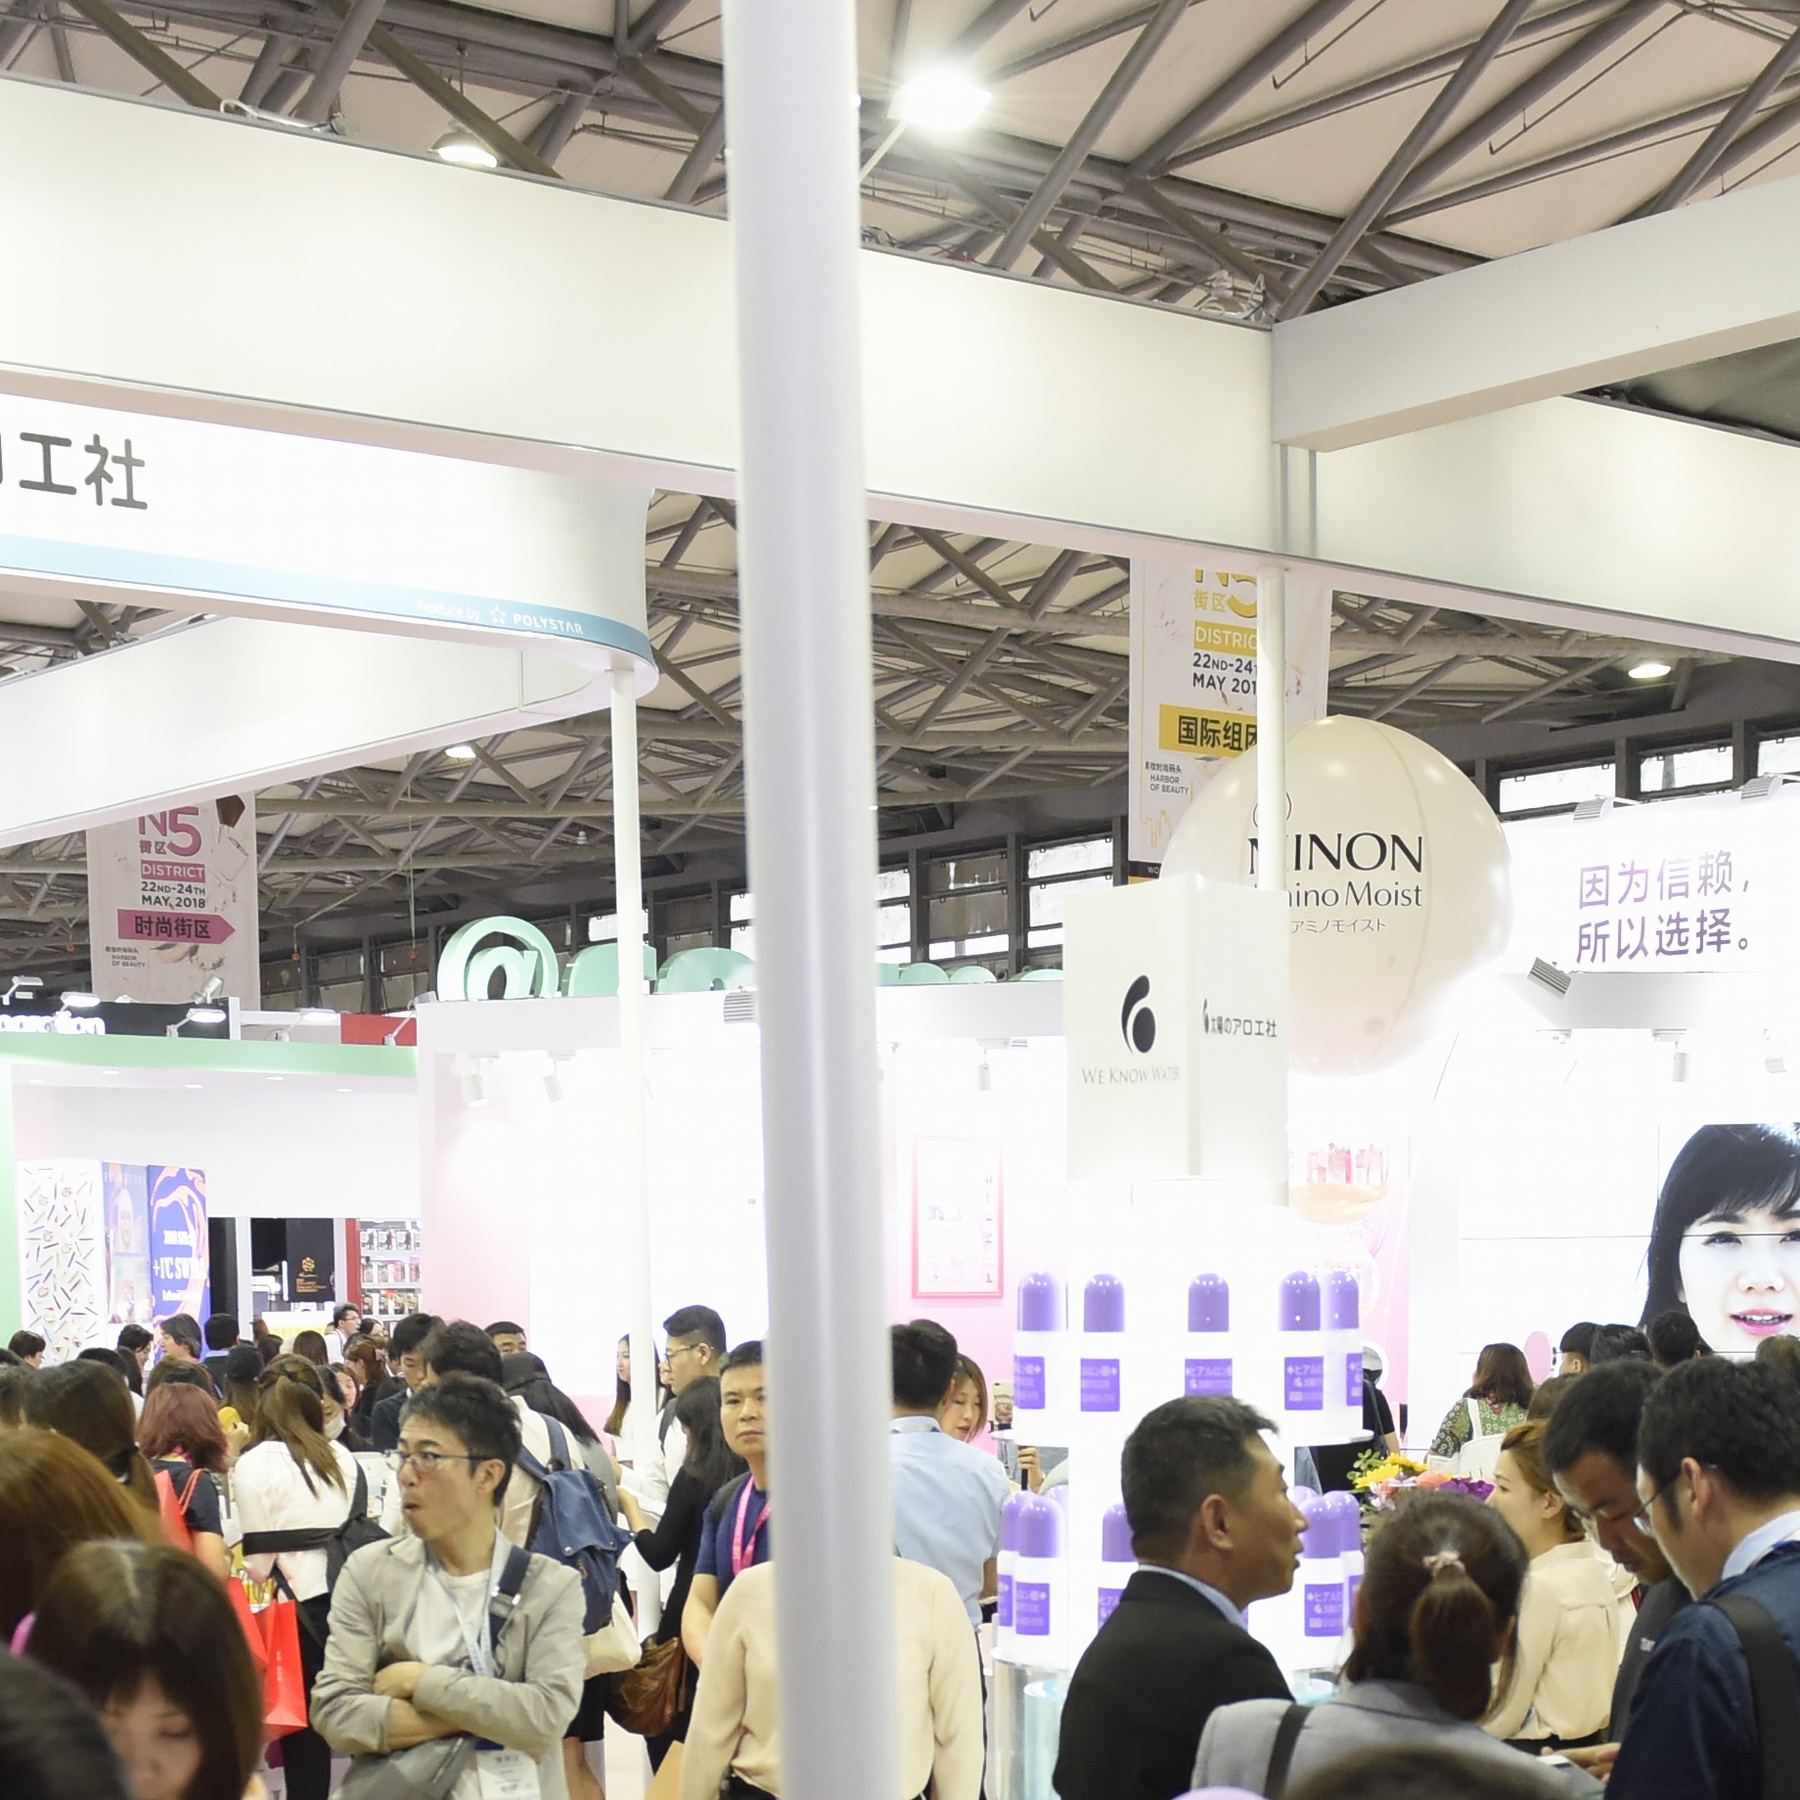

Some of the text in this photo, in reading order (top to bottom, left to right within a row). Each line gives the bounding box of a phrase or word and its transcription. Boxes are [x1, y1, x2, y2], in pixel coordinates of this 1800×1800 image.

[415, 599, 584, 636] Produce by POLYSTAR
[1195, 626, 1257, 650] DISTRIC
[1193, 652, 1257, 675] 22ND-24
[1193, 672, 1257, 696] MAY 201
[1150, 774, 1180, 785] HARBOR
[1150, 783, 1189, 795] OF BEAUTY
[138, 805, 202, 857] N5
[142, 862, 205, 879] DISTRICT
[140, 881, 205, 896] 22ND-24TH
[1345, 880, 1424, 907] Moist
[175, 896, 206, 909] 2018
[134, 914, 212, 939] 时尚街区
[1290, 917, 1387, 934] アミノモイスト
[1081, 1067, 1105, 1085] WE
[1109, 1067, 1150, 1084] KNOW
